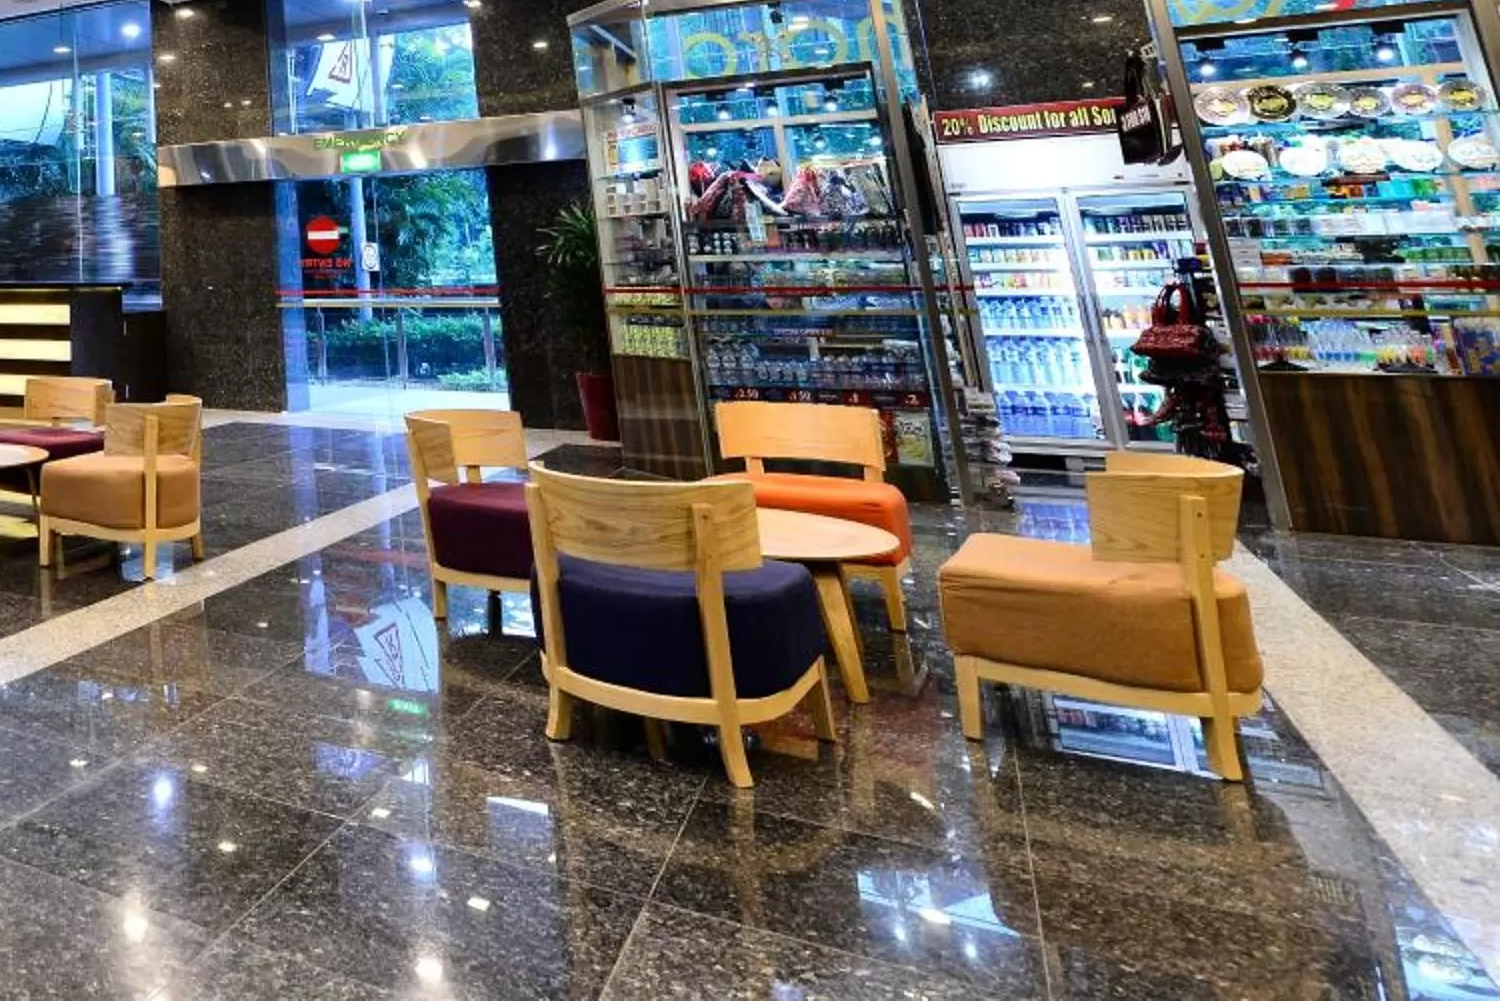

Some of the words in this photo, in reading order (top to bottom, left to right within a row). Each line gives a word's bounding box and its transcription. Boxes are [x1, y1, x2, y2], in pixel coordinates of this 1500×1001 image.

[941, 118, 973, 136] 20%
[977, 111, 1043, 133] Discount
[1044, 109, 1066, 129] for
[1069, 106, 1090, 127] all
